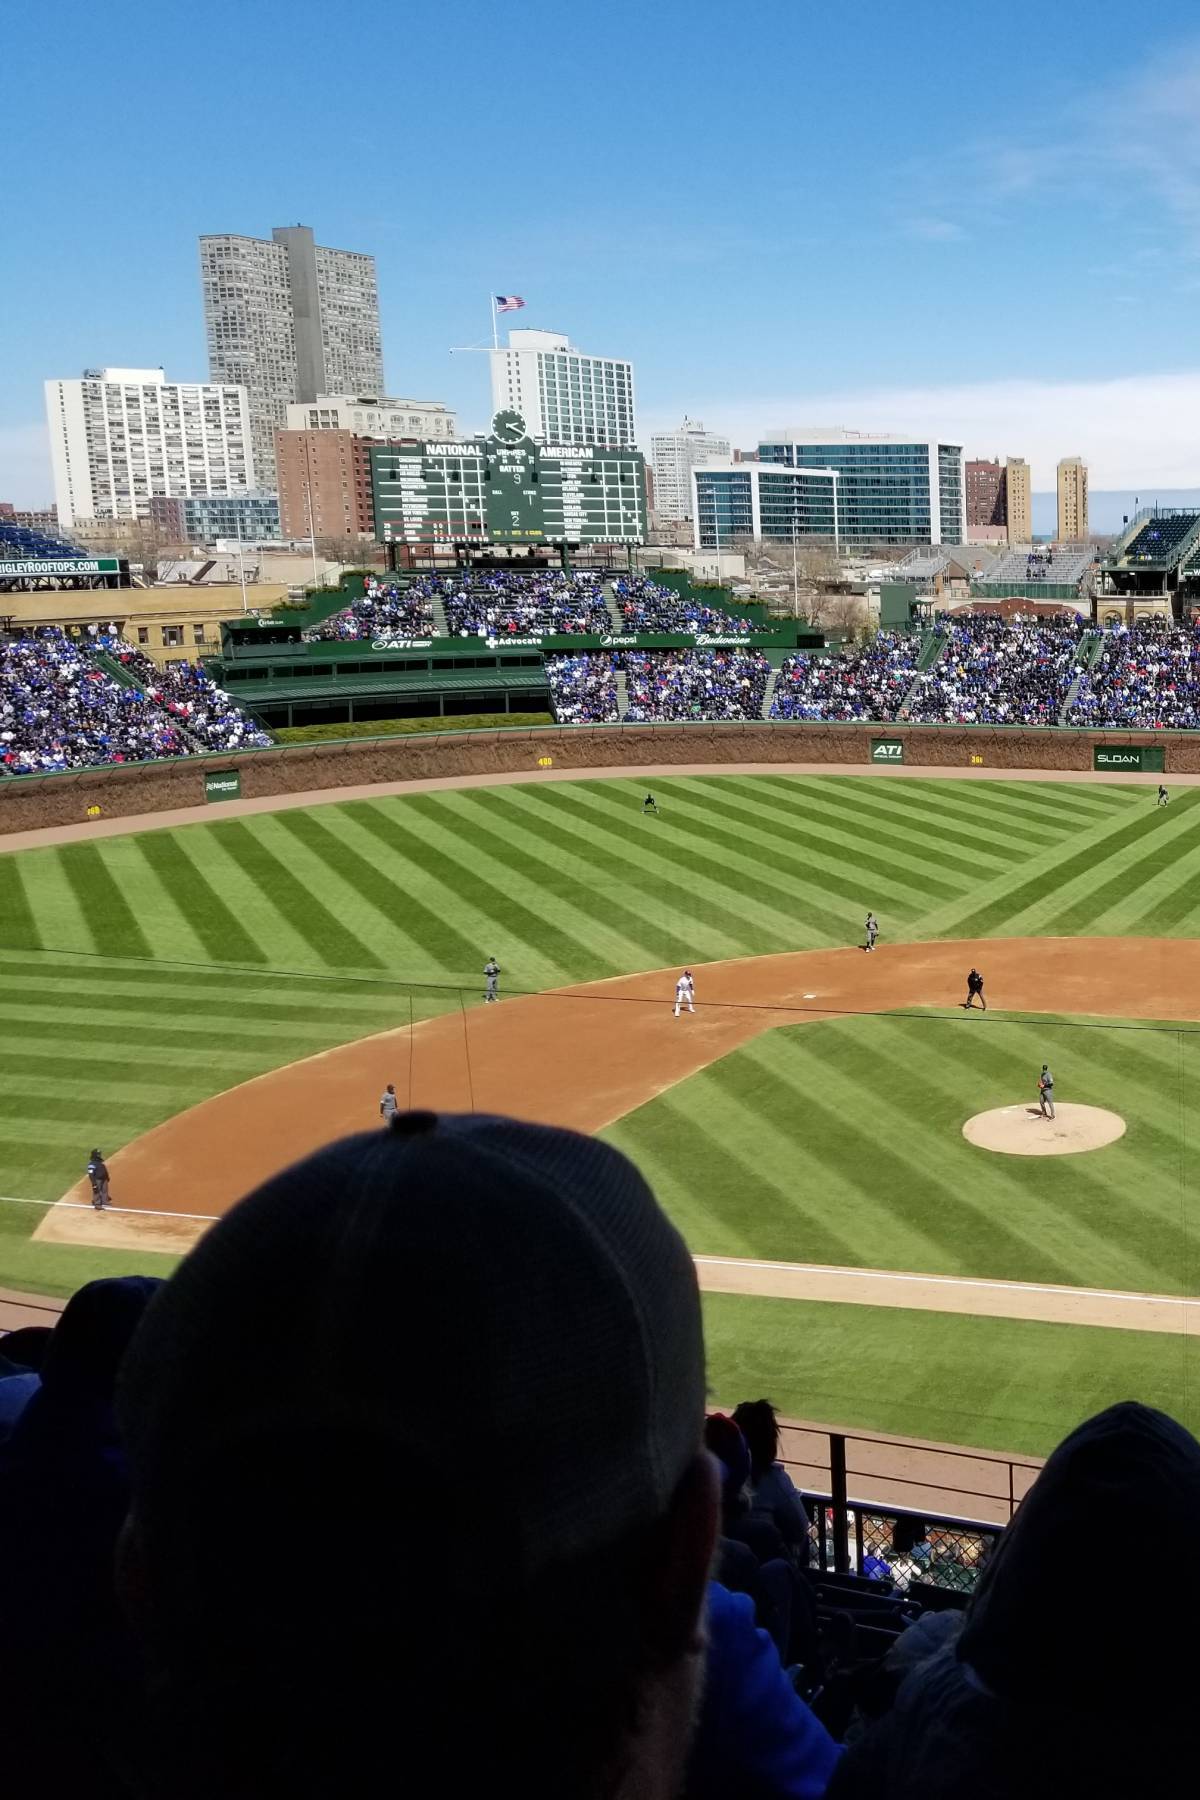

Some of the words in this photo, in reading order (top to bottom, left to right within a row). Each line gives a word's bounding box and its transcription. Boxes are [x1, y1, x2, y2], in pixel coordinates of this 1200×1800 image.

[426, 444, 482, 456] NATIONAL
[540, 447, 593, 458] AMERICAN
[512, 516, 520, 526] 2
[387, 640, 410, 648] ATI
[613, 636, 637, 645] pepsi
[695, 634, 750, 645] Budweiser
[873, 745, 902, 754] ATI
[1097, 754, 1139, 763] SLOAN
